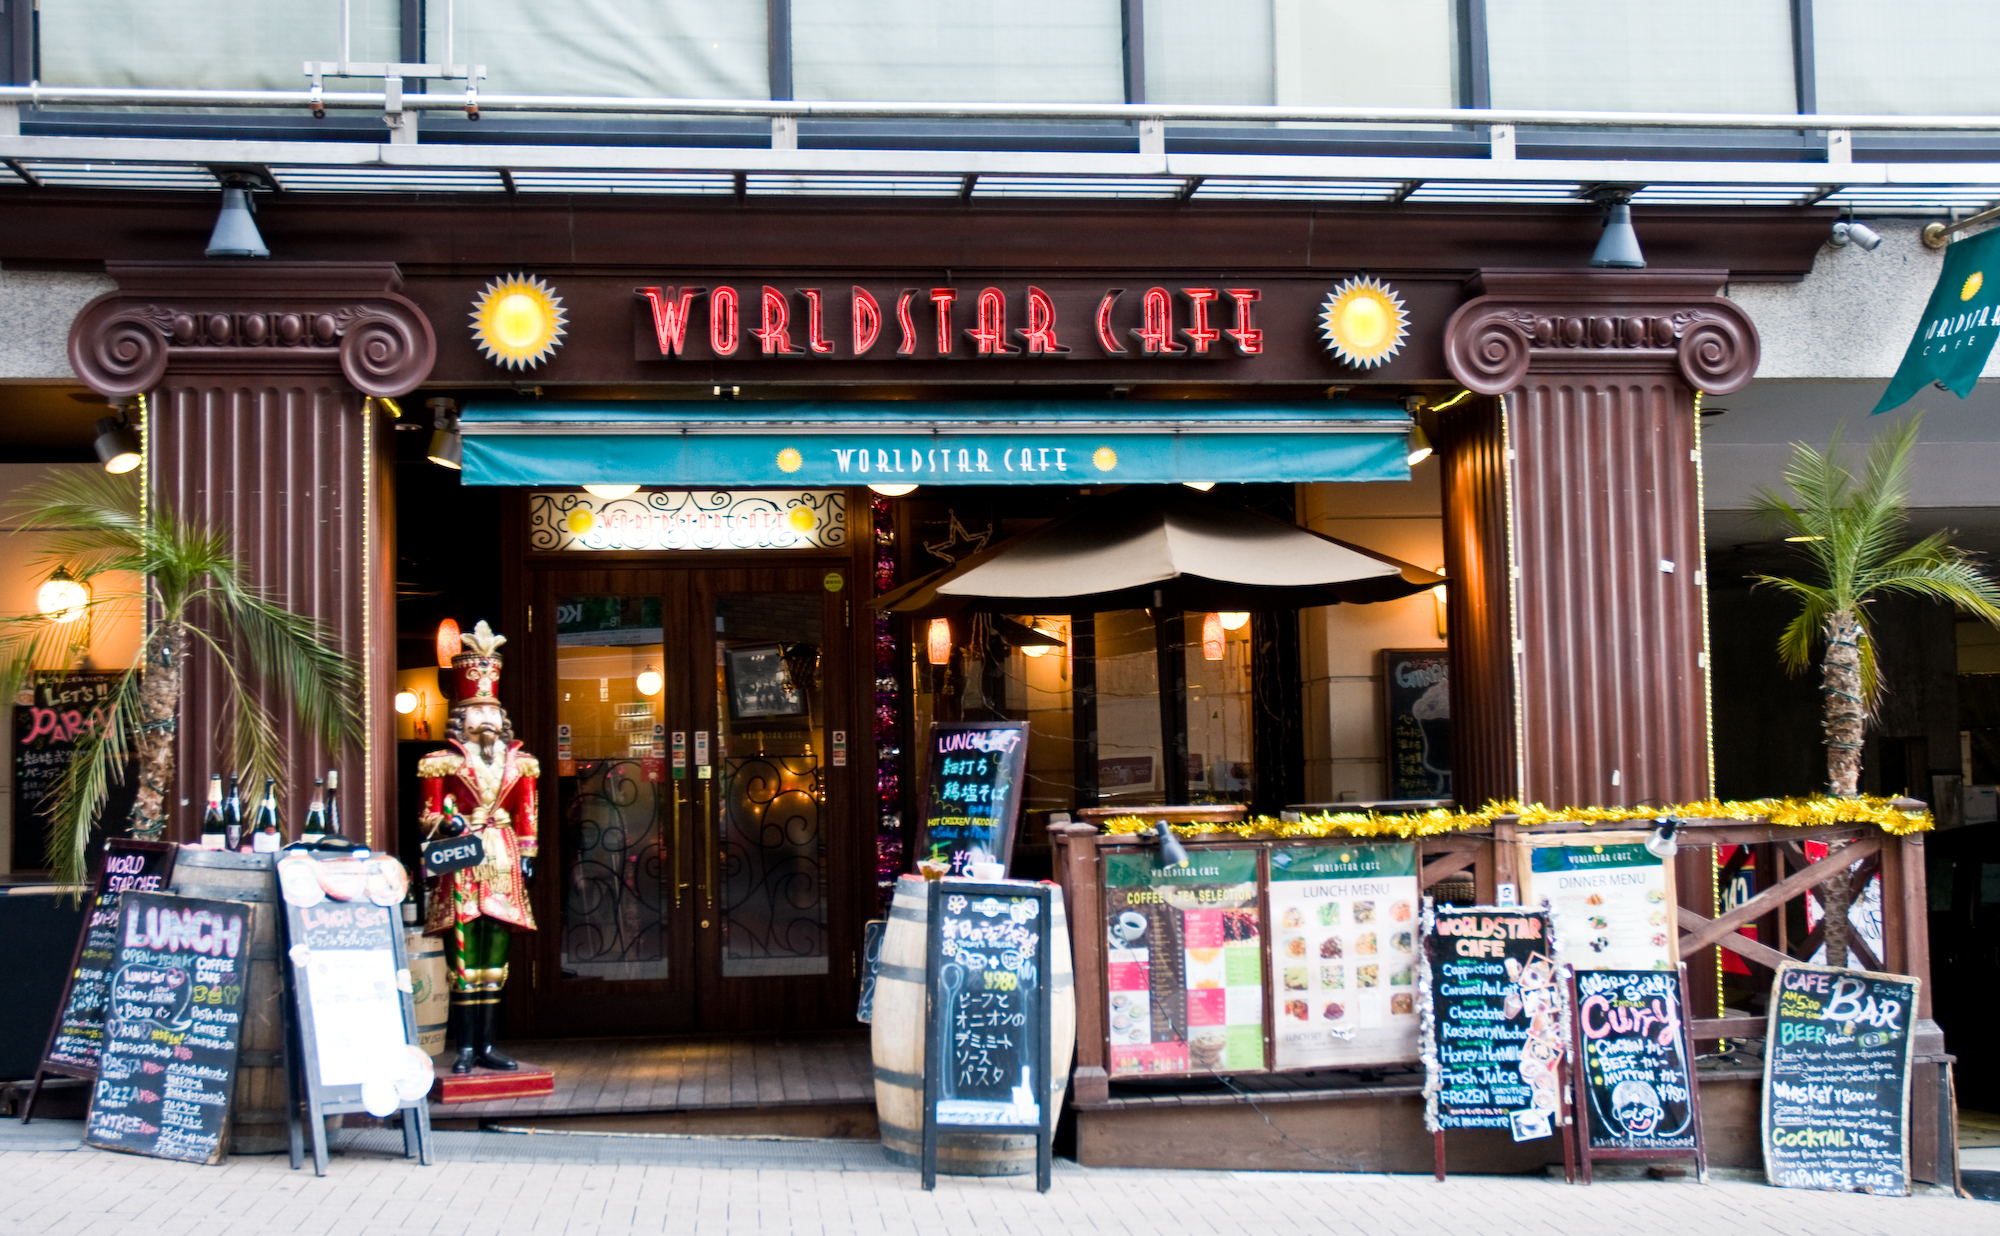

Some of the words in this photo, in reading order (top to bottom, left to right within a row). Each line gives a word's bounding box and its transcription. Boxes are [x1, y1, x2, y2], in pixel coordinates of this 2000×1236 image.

[633, 284, 1071, 357] WORLDSTAR
[1093, 287, 1264, 357] CAFE
[1923, 336, 1976, 356] CAFE
[831, 447, 993, 474] WORLDSTAR
[1003, 447, 1068, 473] CAFE
[939, 732, 986, 754] LUNCH
[942, 757, 988, 776] 細打ち
[942, 781, 1010, 802] 鶏塩そば
[431, 843, 478, 865] OPEN
[107, 855, 145, 874] WORLD
[1303, 884, 1348, 898] LUNCH
[1351, 883, 1390, 896] MENU
[1559, 876, 1607, 889] DINNER
[1610, 873, 1646, 886] MENU
[1127, 891, 1165, 905] COFFEE
[1177, 890, 1196, 902] TEA
[1198, 888, 1252, 902] SELECTION
[301, 907, 353, 930] LUNCH
[125, 900, 242, 958] LUNCH
[122, 949, 150, 964] OPEN
[1456, 939, 1506, 958] CAFE
[196, 956, 235, 972] COFFEE
[1442, 963, 1504, 981] Cappuccino
[196, 971, 221, 984] CAKE
[959, 992, 1010, 1009] ビーフと
[1782, 990, 1798, 1001] AM
[1783, 971, 1830, 994] CAFE
[1819, 975, 1902, 1031] BAR
[955, 1009, 1026, 1029] オニオンの
[1449, 1005, 1507, 1021] Chocolate
[1581, 995, 1682, 1047] Curry
[1780, 1022, 1826, 1046] BEER
[102, 1053, 142, 1074] PASTA
[956, 1050, 993, 1066] ソース
[1598, 1054, 1638, 1073] BEEF
[958, 1063, 1005, 1087] パスタ
[1440, 1067, 1478, 1085] Fresh
[1477, 1065, 1519, 1085] Juice
[1603, 1068, 1656, 1087] MUTTON
[98, 1080, 140, 1104] PIZZA
[1440, 1088, 1490, 1104] FROZEN
[1772, 1081, 1834, 1105] WHISKEY
[90, 1111, 143, 1131] ENTREE
[1772, 1127, 1851, 1148] COCKTAIL
[1779, 1168, 1854, 1191] JAPANESE
[1854, 1170, 1895, 1188] SAKE
